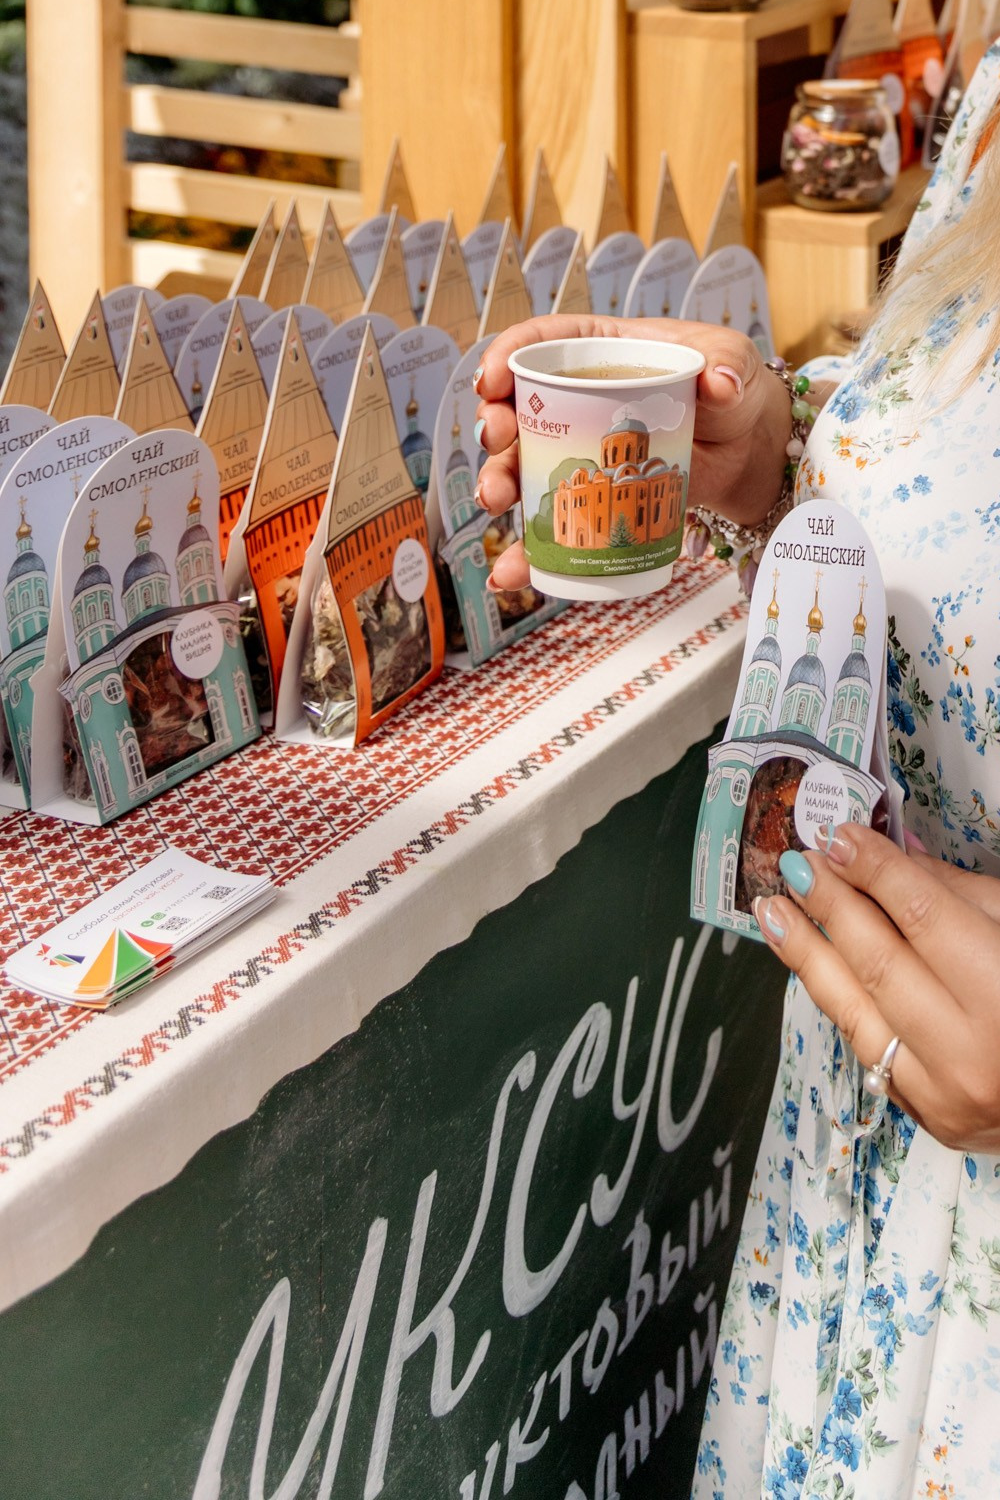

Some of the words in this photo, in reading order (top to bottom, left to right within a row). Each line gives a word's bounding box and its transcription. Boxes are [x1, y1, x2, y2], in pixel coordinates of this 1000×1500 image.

[540, 419, 571, 435] ФЕСТ
[57, 427, 91, 451] ЧАЙ
[132, 441, 164, 464] ЧАЙ
[286, 449, 311, 471] ЧАЙ
[88, 449, 200, 502] СМОЛЕНСКИЙ
[260, 460, 335, 507] СМОЛЕНСКИ
[358, 466, 379, 488] ЧАЙ
[335, 473, 404, 525] СМОЛЕНСКИЙ
[807, 514, 835, 536] ЧАЙ
[569, 556, 586, 565] Храм
[773, 541, 866, 567] СМОЛЕНСКИЙ
[175, 621, 213, 642] КЛУБНИКА
[180, 632, 213, 652] МАЛИНА
[804, 780, 844, 798] КЛУБНИКА
[804, 796, 839, 812] МАЛИНА
[805, 810, 834, 825] ВИШНЯ
[67, 913, 109, 941] Слобода
